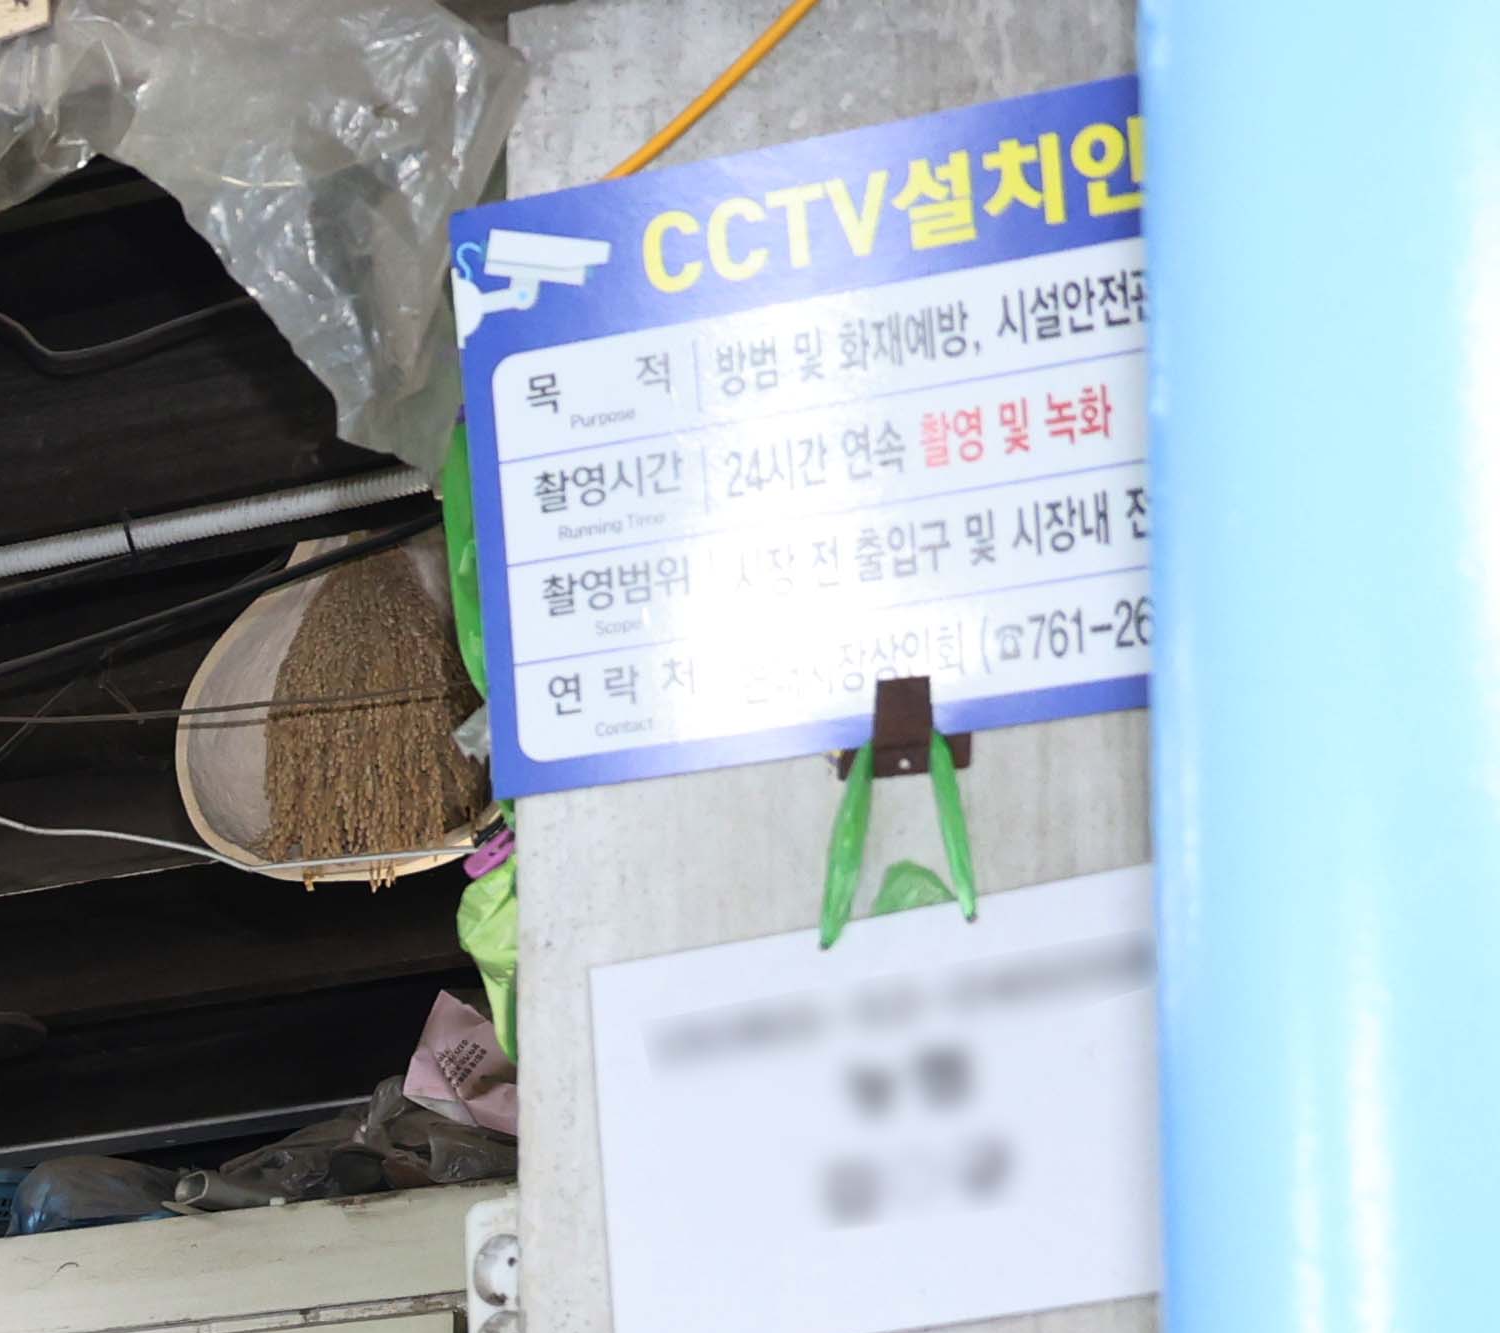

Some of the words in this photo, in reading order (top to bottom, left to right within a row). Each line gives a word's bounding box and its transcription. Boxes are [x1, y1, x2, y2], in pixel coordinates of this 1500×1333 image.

[716, 341, 779, 397] 방범
[794, 330, 826, 382] 및
[838, 301, 983, 372] 화재예방,
[570, 406, 636, 430] Purpose
[533, 452, 683, 515] 촬영시간
[724, 437, 829, 501] 24시간
[841, 423, 906, 479] 연속
[920, 408, 985, 470] 촬영
[999, 398, 1031, 454] 및
[1046, 385, 1113, 442] 녹화
[541, 555, 692, 618] 촬영범위
[855, 519, 953, 580] 출입구
[965, 511, 997, 567] 및
[1012, 490, 1111, 556] 시장내
[558, 516, 623, 543] Running
[594, 715, 657, 739] Contact
